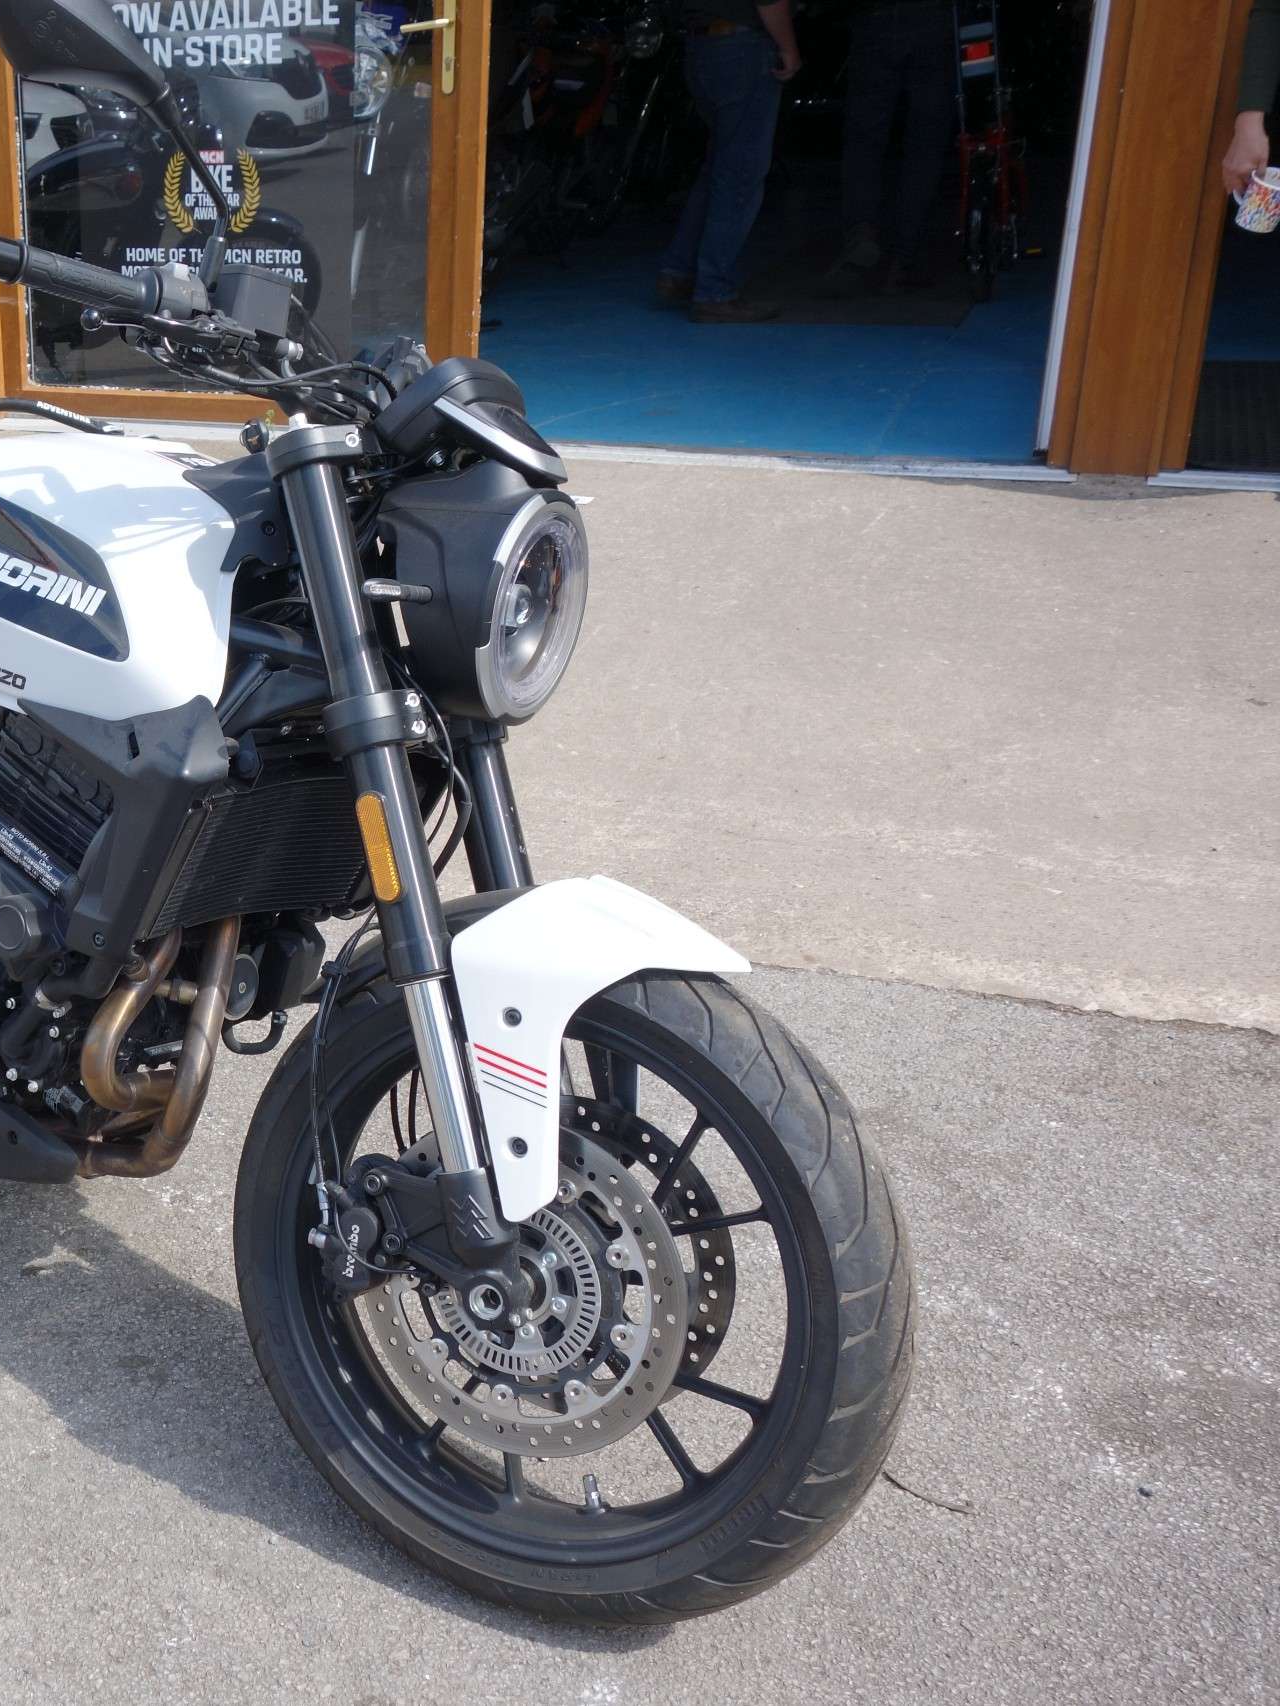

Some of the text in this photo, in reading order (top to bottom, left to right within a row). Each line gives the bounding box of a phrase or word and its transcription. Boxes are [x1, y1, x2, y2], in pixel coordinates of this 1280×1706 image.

[112, 0, 340, 34] OW AVAILABLE
[190, 164, 233, 193] BKE
[193, 207, 217, 220] AWA
[126, 247, 301, 264] HOME OF TH MCN RETRO
[342, 1224, 360, 1278] brembo
